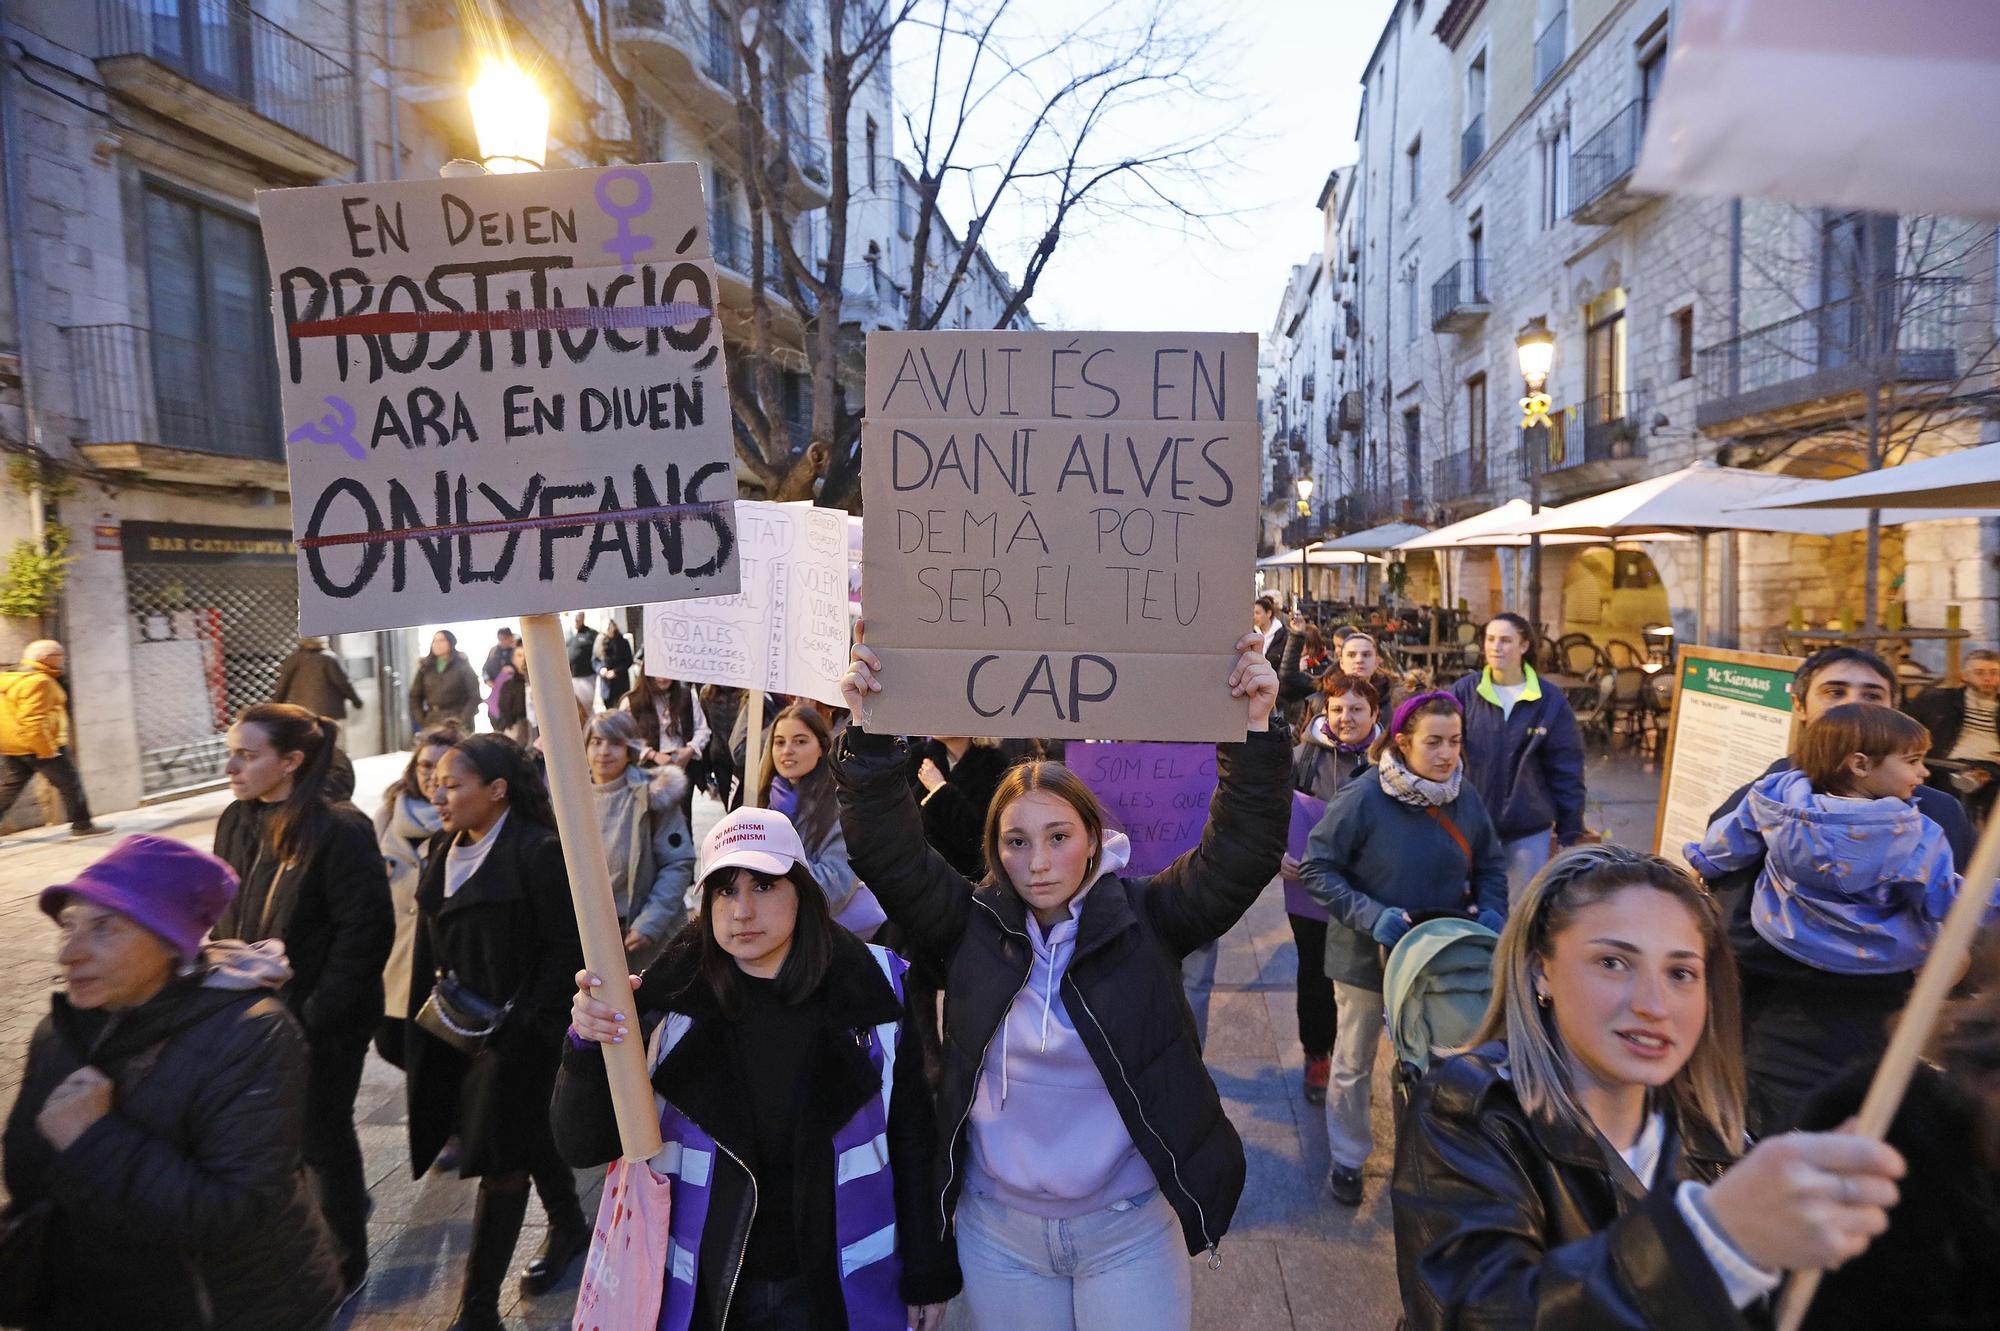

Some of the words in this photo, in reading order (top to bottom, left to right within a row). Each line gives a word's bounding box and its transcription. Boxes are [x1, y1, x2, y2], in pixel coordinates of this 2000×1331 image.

[342, 197, 410, 258] EN
[441, 193, 578, 247] DEIEN
[882, 347, 1023, 417] AVUI
[1051, 338, 1121, 419] ÉS
[1153, 348, 1226, 421] EN
[371, 386, 479, 450] ARA
[503, 385, 565, 443] EN
[580, 377, 705, 432] DIUEN
[892, 427, 1038, 497] DANI
[1057, 432, 1234, 508] ALVES
[304, 462, 735, 599] ONLYFANS
[897, 500, 1049, 558] DEMÀ
[1089, 507, 1195, 564] POT
[917, 566, 1012, 627] SER
[1034, 564, 1076, 626] EL
[1105, 566, 1201, 627] TEU
[663, 620, 687, 638] NO
[668, 656, 745, 674] MASCLISTES
[967, 653, 1118, 723] CAP
[1089, 756, 1141, 783] SOM
[1153, 758, 1184, 780] EL
[1119, 791, 1154, 808] LES
[1173, 792, 1206, 810] QUE
[722, 833, 766, 846] FIMINISMI
